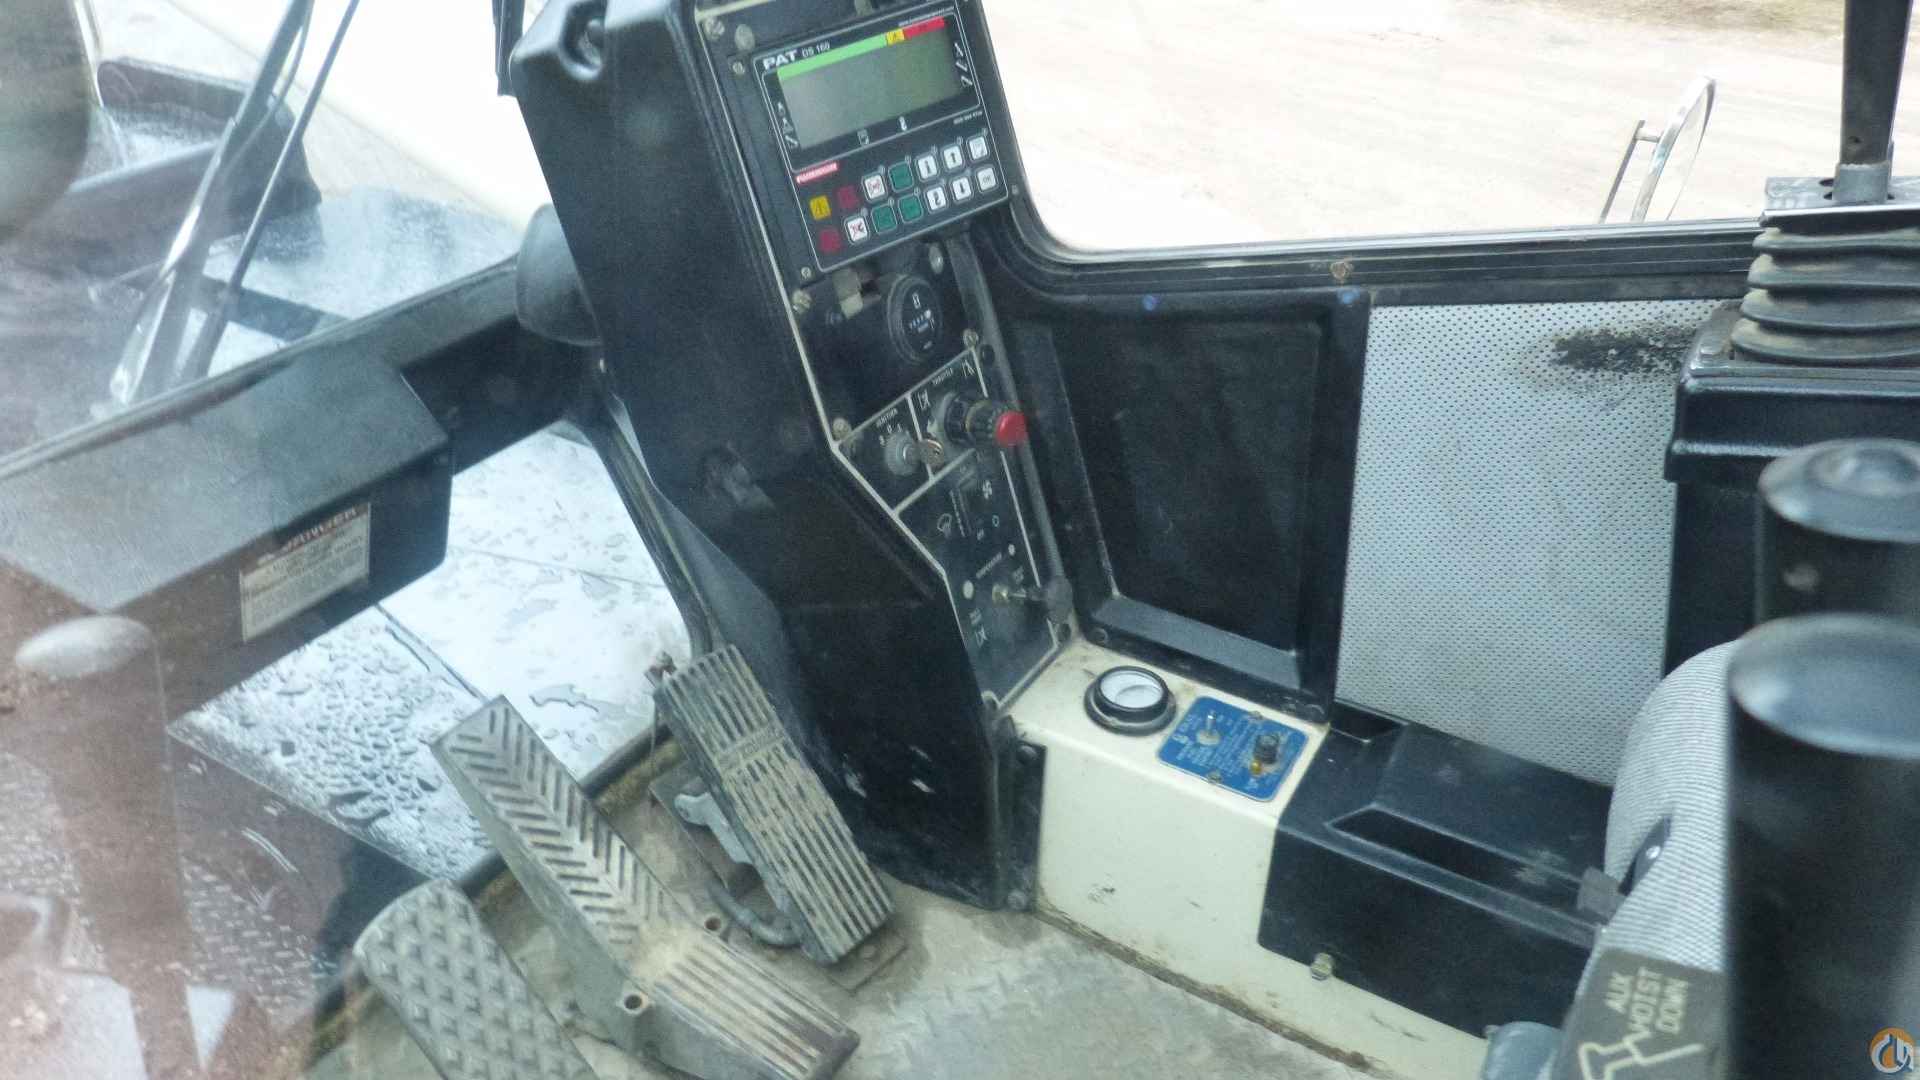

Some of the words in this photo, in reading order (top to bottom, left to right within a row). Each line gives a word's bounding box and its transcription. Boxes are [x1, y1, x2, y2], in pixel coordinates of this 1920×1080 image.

[763, 48, 797, 70] PAT
[1605, 971, 1631, 1015] AUX
[1655, 977, 1690, 1035] DOWN
